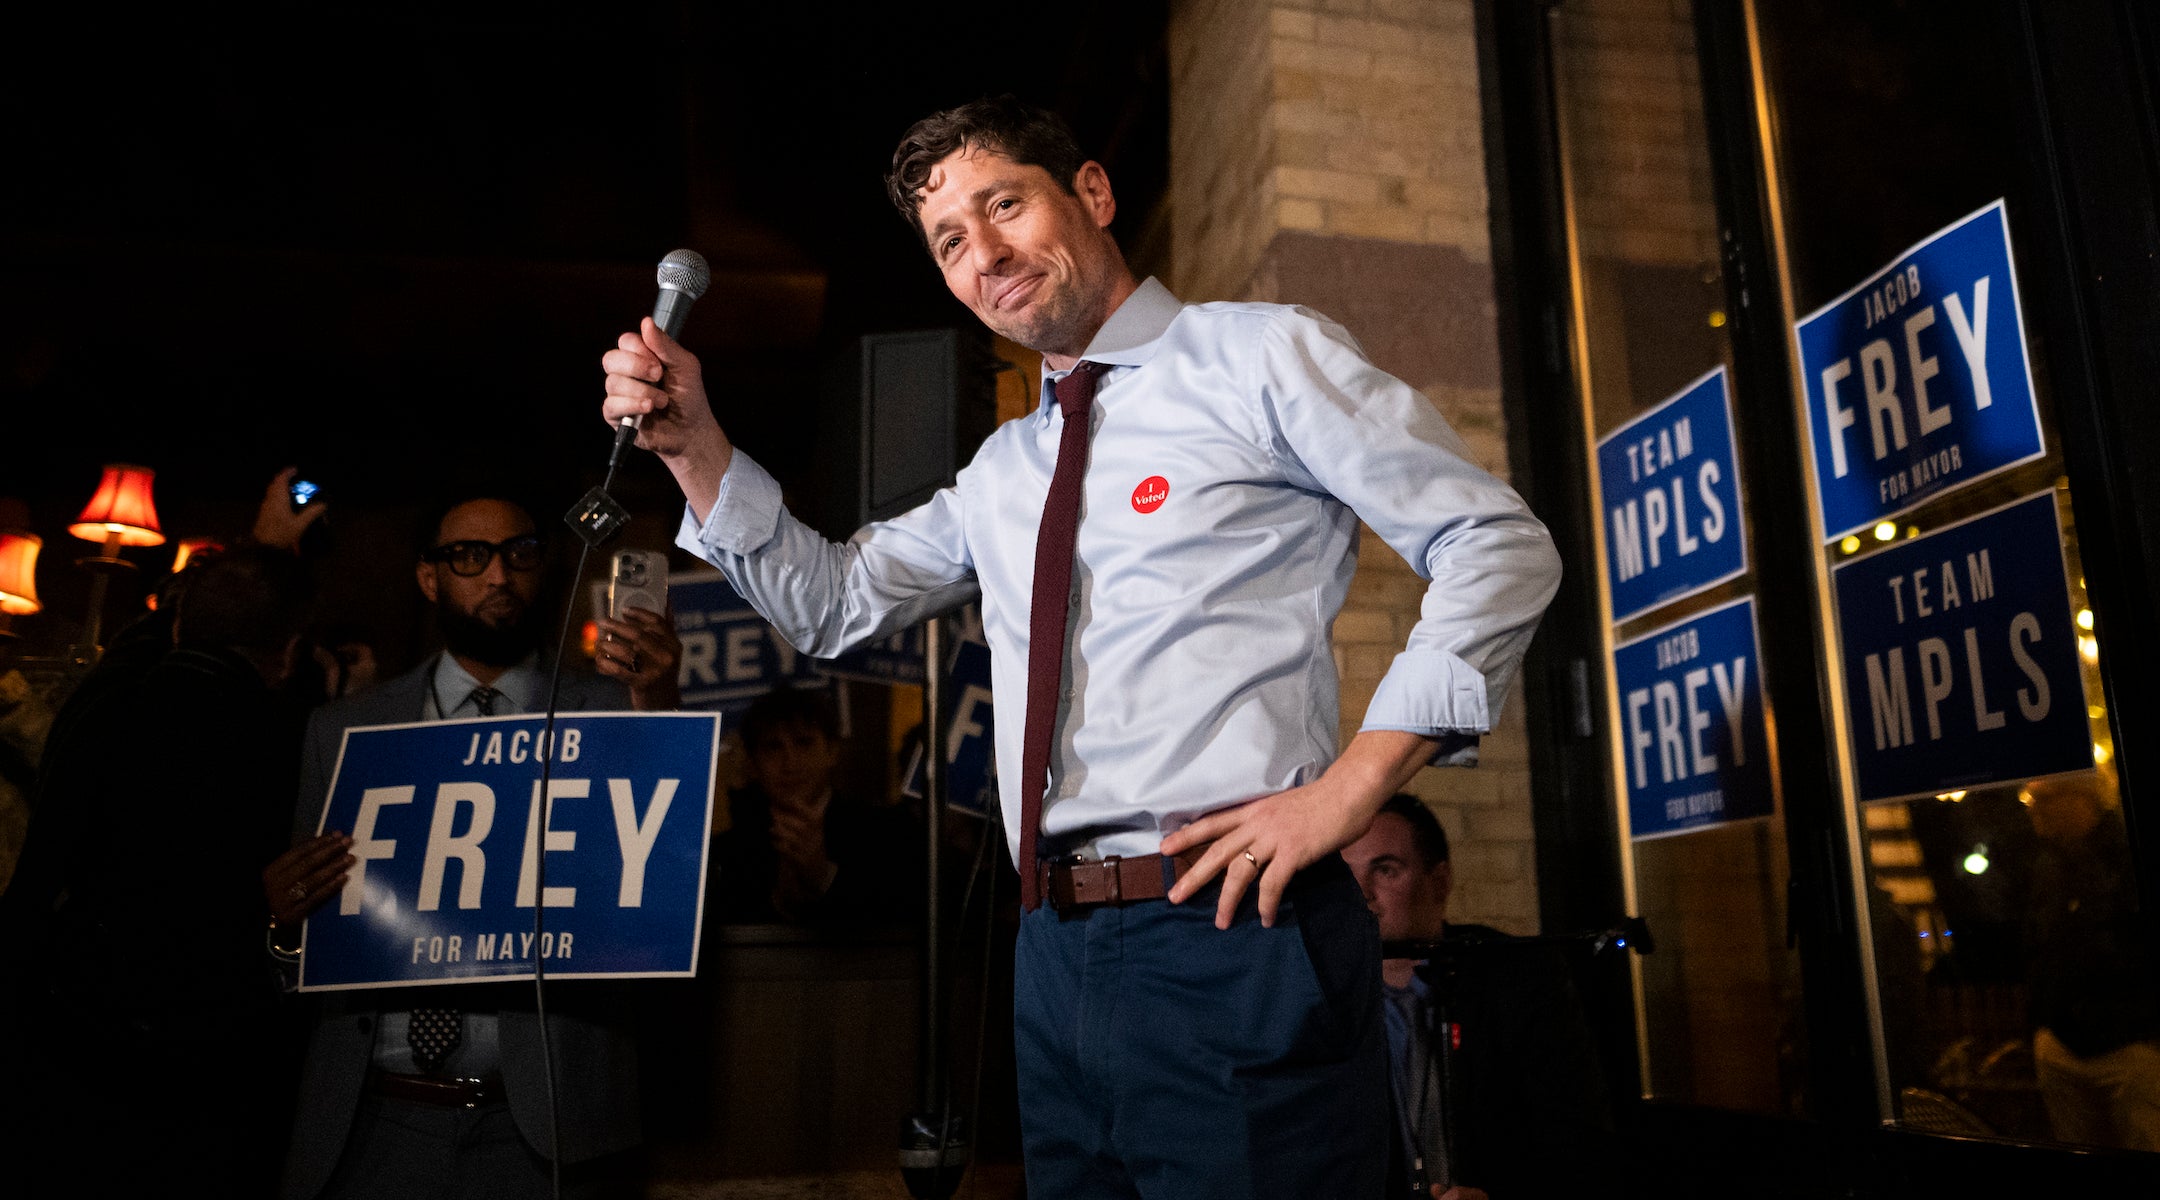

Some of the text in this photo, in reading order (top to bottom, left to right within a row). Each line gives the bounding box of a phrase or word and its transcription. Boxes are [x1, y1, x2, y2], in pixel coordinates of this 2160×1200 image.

[1864, 264, 1922, 329] JACOB
[1821, 275, 1993, 479] FREY
[1627, 416, 1694, 483] TEAM
[1880, 470, 1908, 504] FOR
[1911, 443, 1963, 488] MAYOR
[1135, 490, 1165, 505] Voted
[1149, 483, 1153, 493] I
[1613, 459, 1725, 583] MPLS
[1888, 548, 1995, 624] TEAM
[677, 624, 797, 688] REY
[1865, 612, 2051, 751] MPLS
[463, 728, 581, 766] JACOB
[1627, 656, 1746, 790] FREY
[339, 778, 681, 916] FREY
[412, 932, 574, 964] FOR MAYOR
